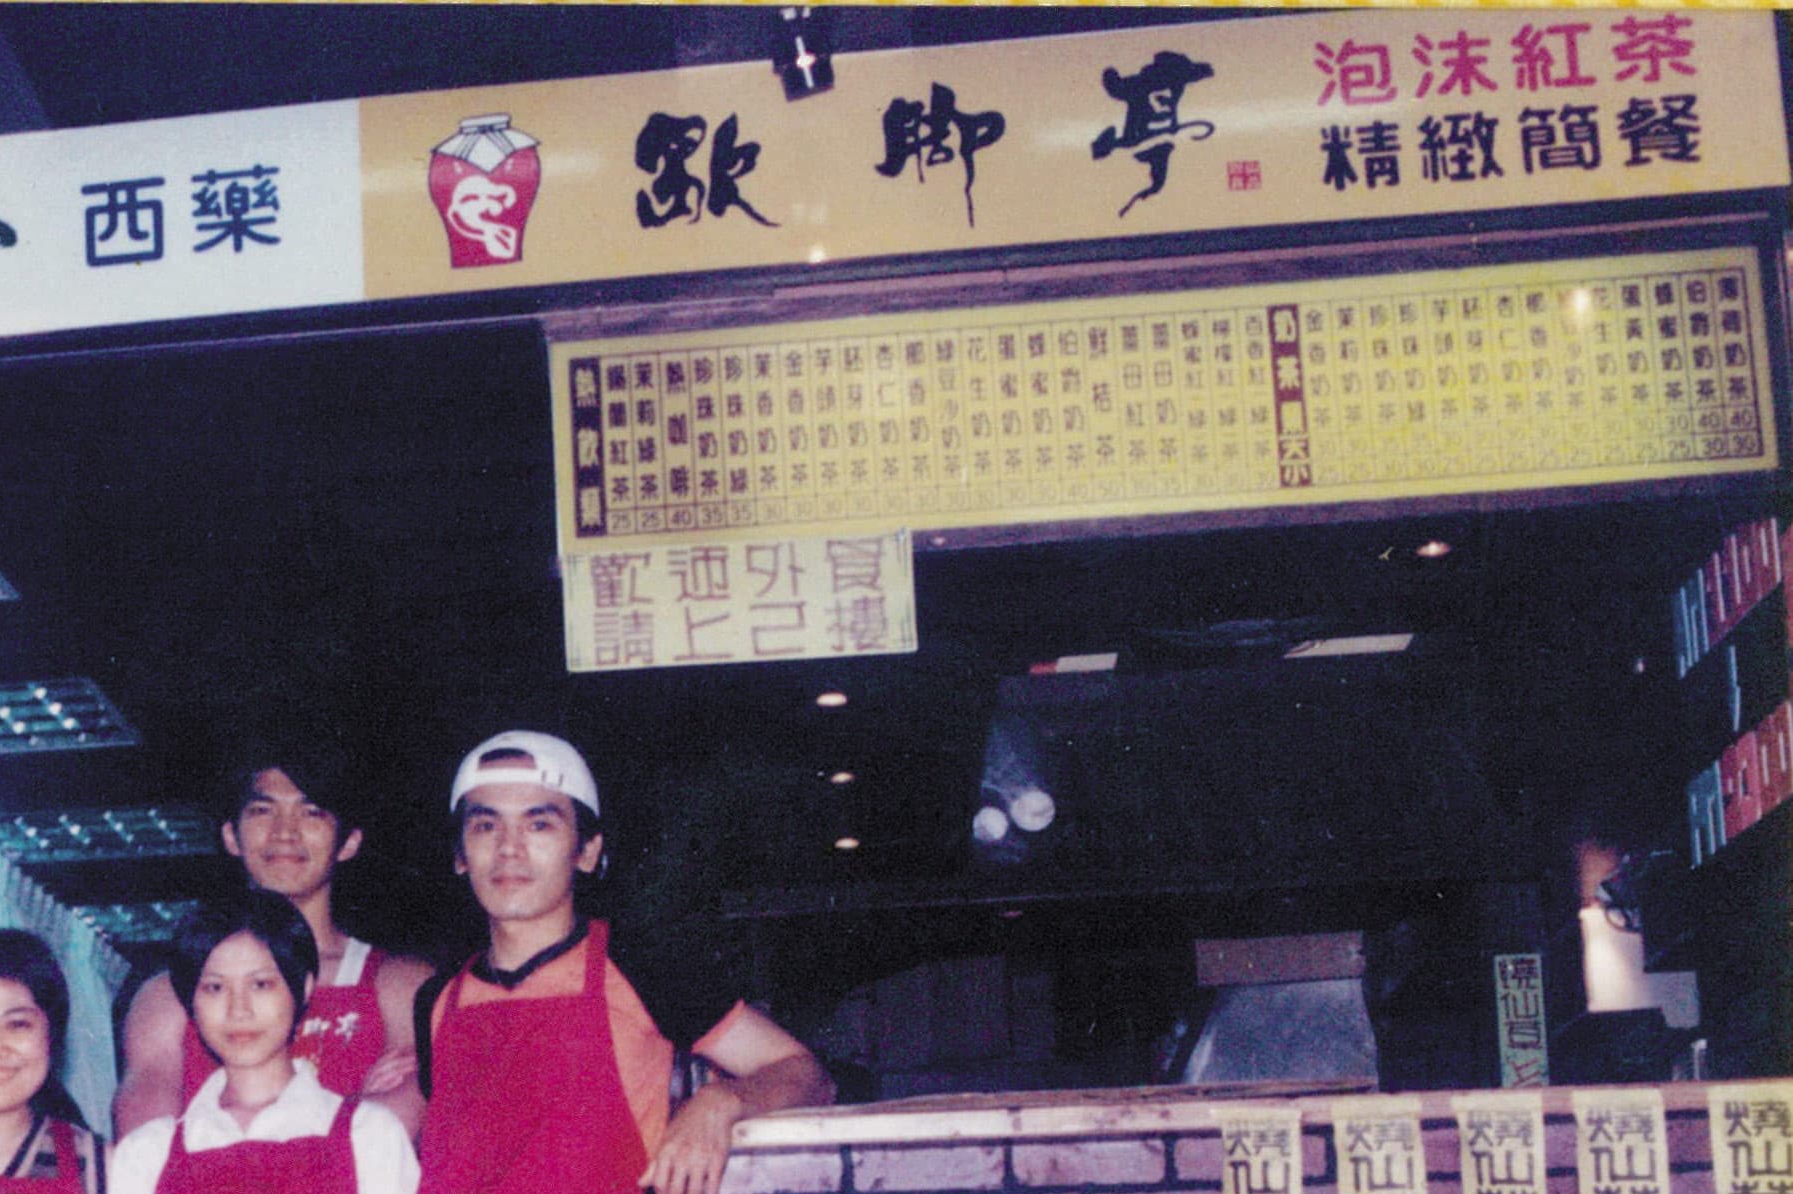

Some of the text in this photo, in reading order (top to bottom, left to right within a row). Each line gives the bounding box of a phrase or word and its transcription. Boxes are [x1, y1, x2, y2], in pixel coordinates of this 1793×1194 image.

[1314, 12, 1700, 105] 泡沫紅茶
[1319, 92, 1703, 193] 精緻簡餐
[82, 166, 283, 268] 西藥
